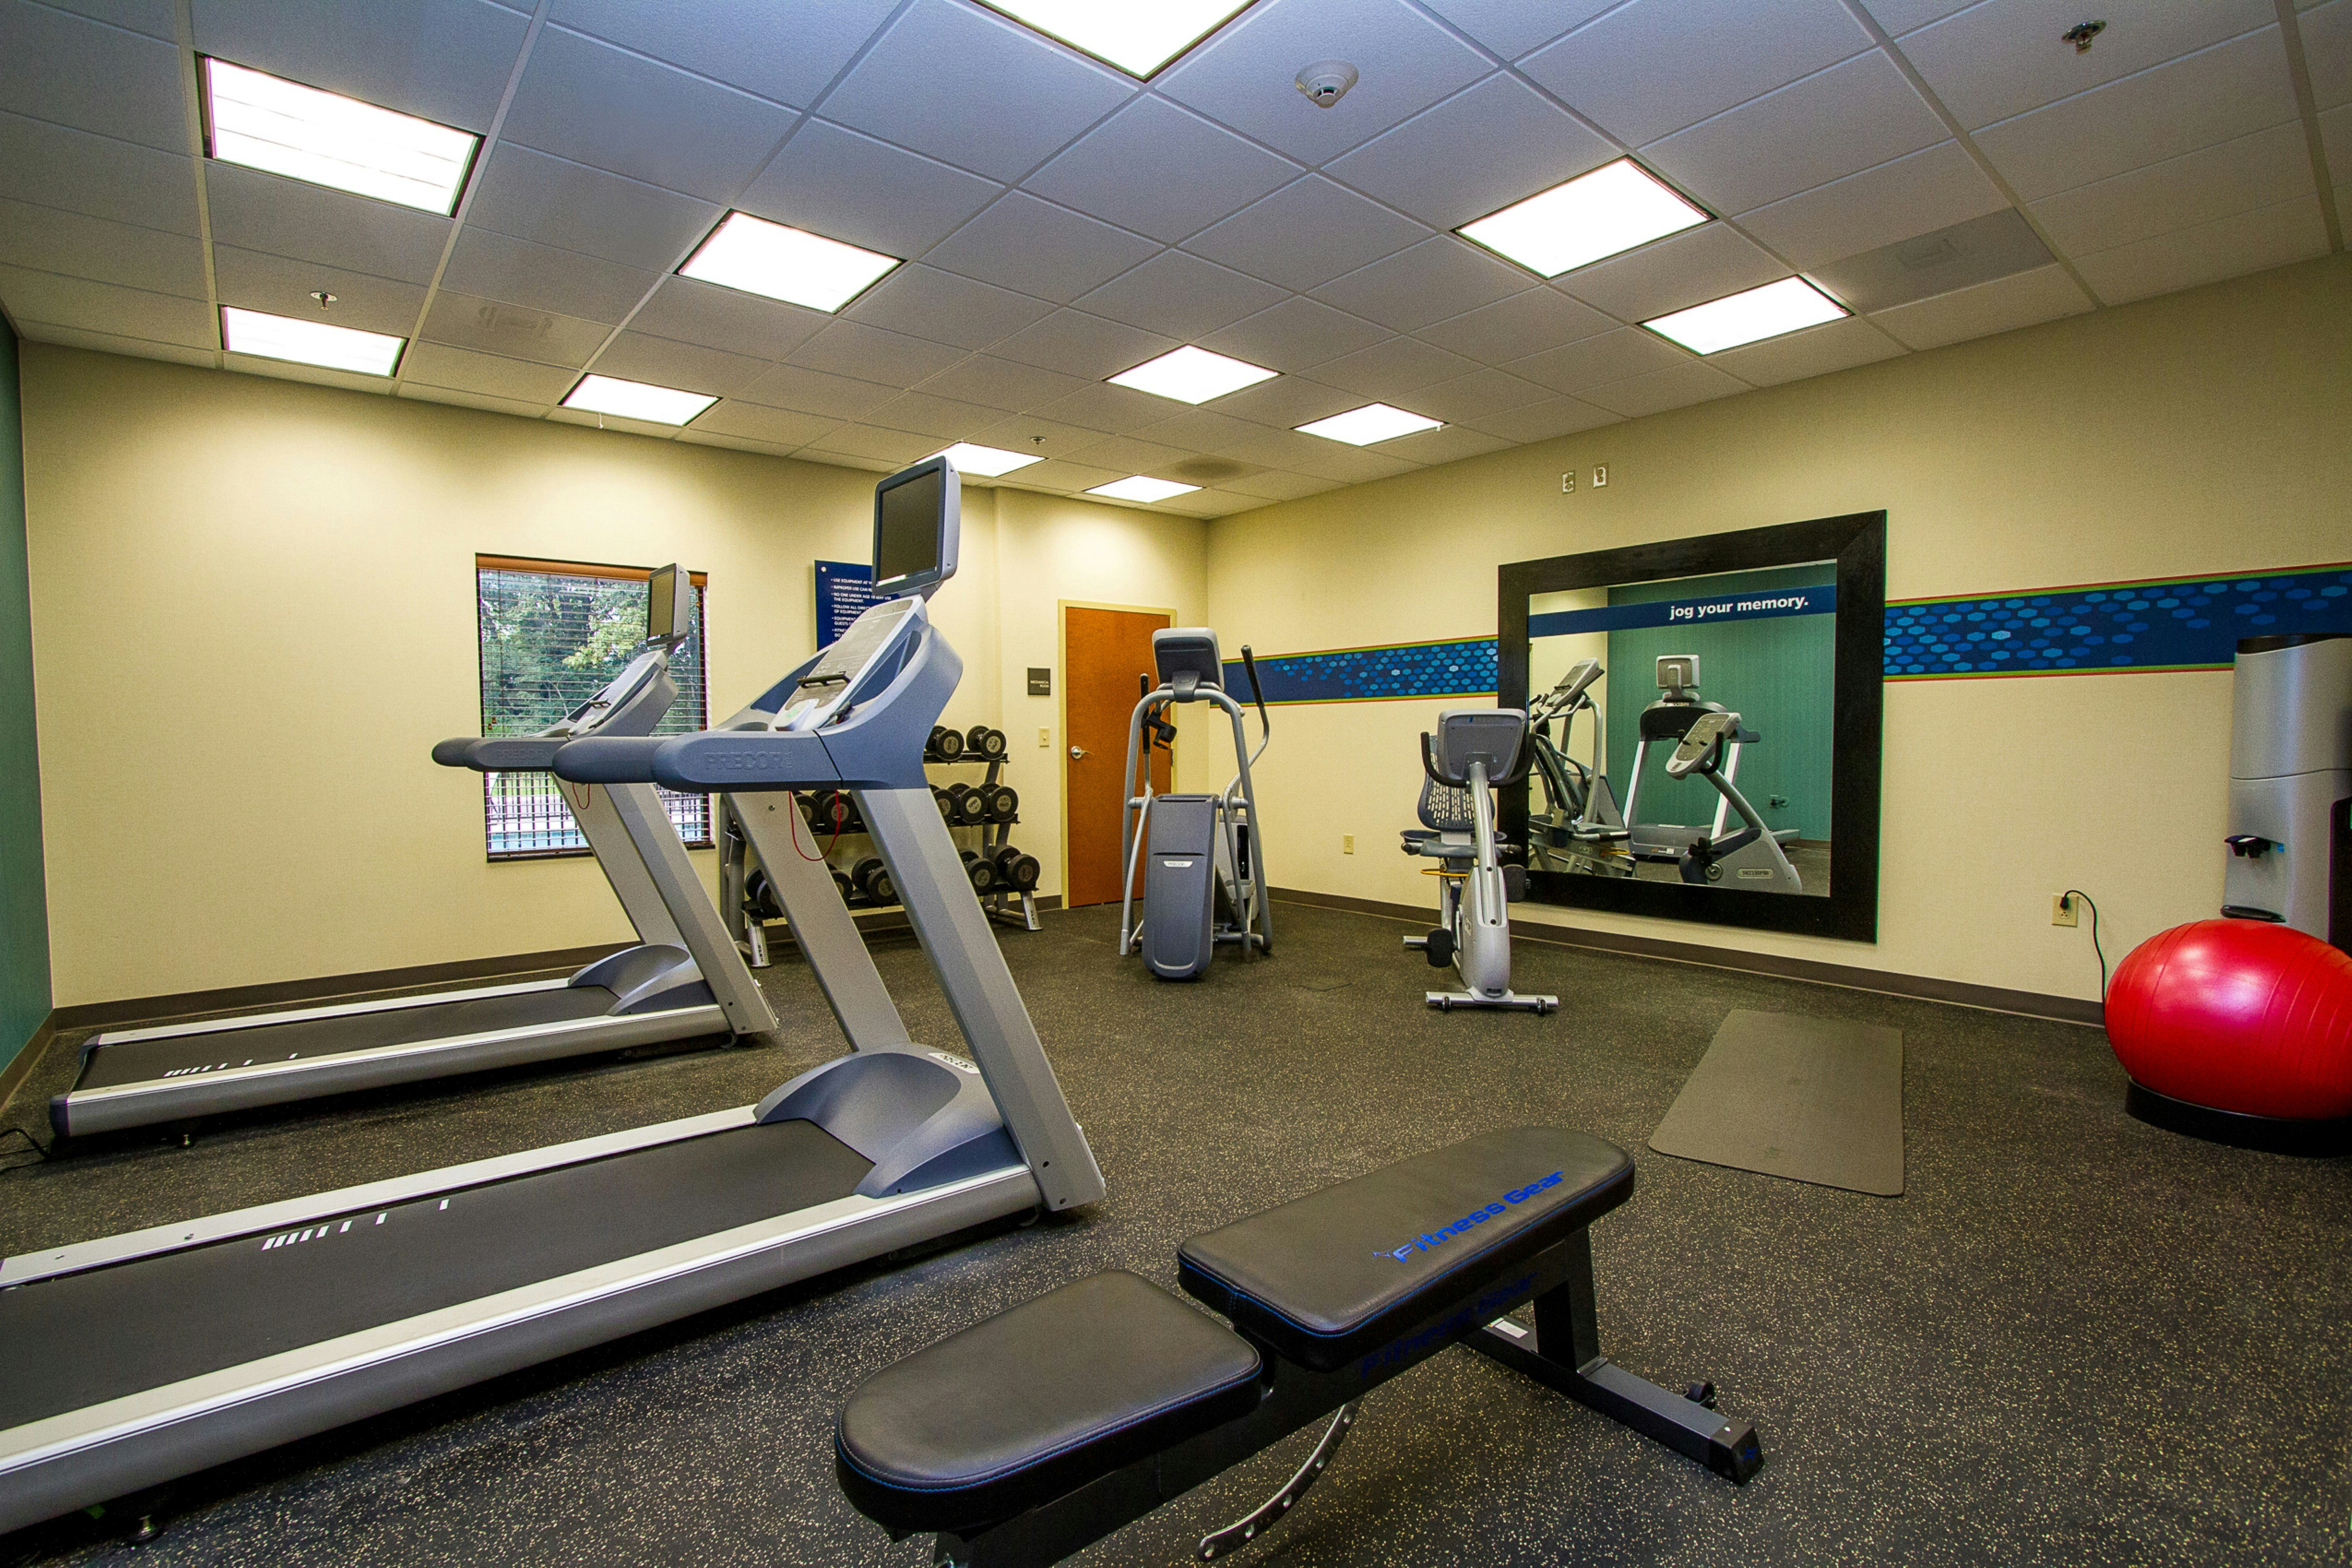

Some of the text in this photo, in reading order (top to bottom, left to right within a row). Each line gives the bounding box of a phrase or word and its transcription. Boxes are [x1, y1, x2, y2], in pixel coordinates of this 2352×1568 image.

[1669, 595, 1809, 621] jog your memory.
[704, 751, 783, 770] PRECOR
[1392, 1170, 1564, 1264] Fitness Gear
[1361, 1307, 1471, 1379] Fitness
